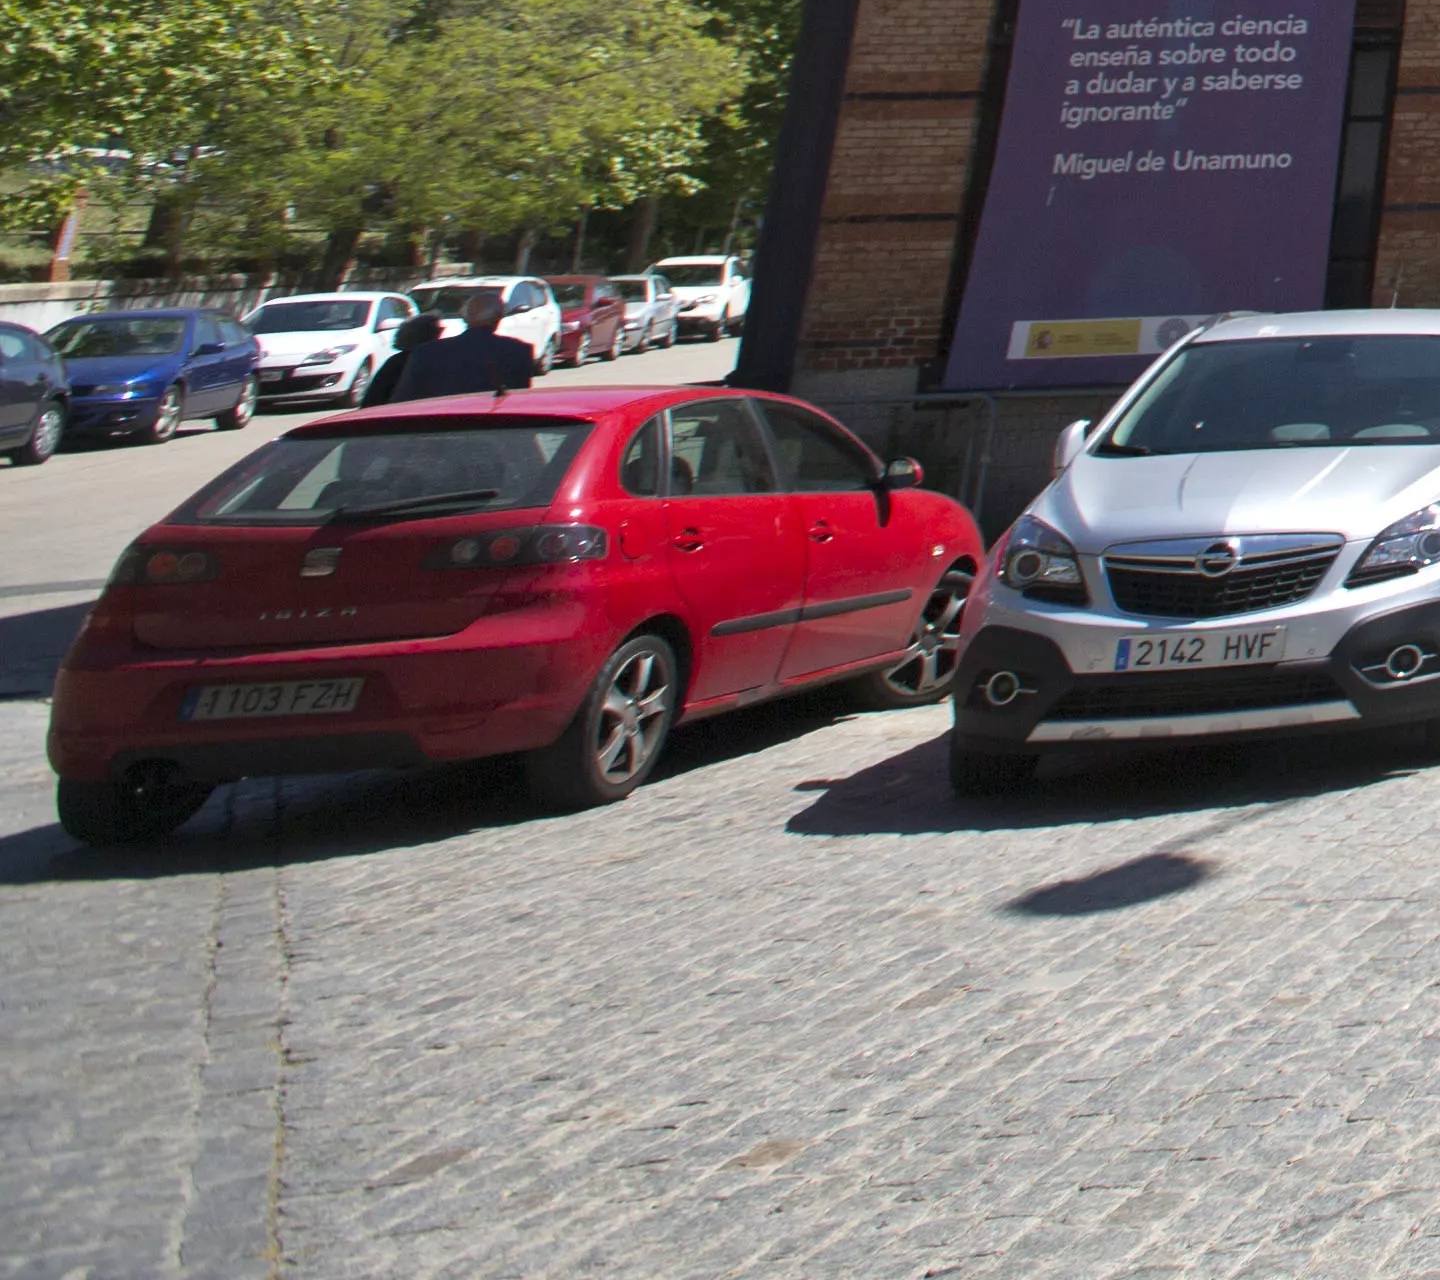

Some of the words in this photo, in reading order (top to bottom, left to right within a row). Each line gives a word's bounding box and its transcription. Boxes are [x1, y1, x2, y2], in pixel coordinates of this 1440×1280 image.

[1105, 17, 1215, 39] auténtica
[1221, 14, 1309, 36] ciencia
[1069, 45, 1152, 67] enseña
[1159, 43, 1226, 65] sobre
[1233, 41, 1297, 63] todo
[1064, 79, 1080, 95] a
[1086, 71, 1157, 94] dudar
[1161, 77, 1178, 98] y
[1181, 75, 1196, 92] a
[1202, 68, 1303, 91] saberse
[1052, 151, 1133, 180] Miguel
[1136, 150, 1166, 172] de
[1172, 150, 1292, 171] Unamuno
[1135, 638, 1205, 666] 2142
[1223, 632, 1277, 660] HVF
[207, 686, 284, 715] 1103
[290, 683, 357, 711] FZH
